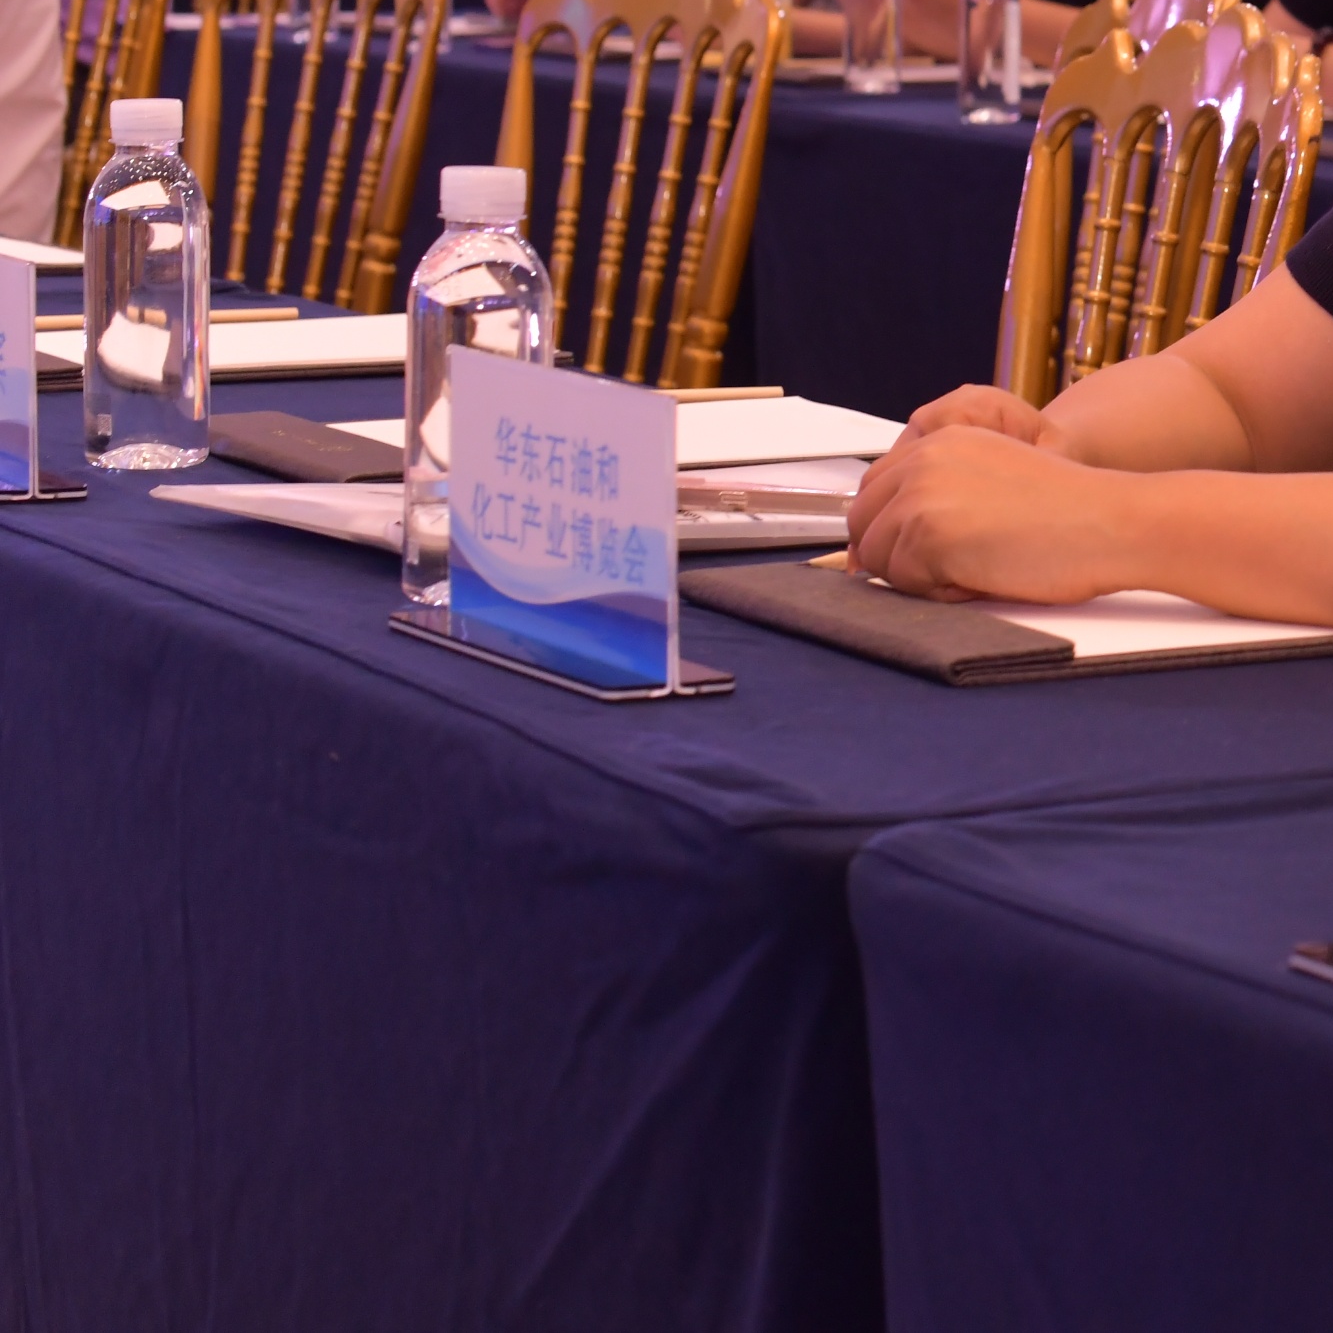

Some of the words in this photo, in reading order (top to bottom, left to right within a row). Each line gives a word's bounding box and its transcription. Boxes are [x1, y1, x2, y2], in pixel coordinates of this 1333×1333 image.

[496, 417, 619, 501] 华东石油和
[471, 482, 648, 585] 化工产业博览会
